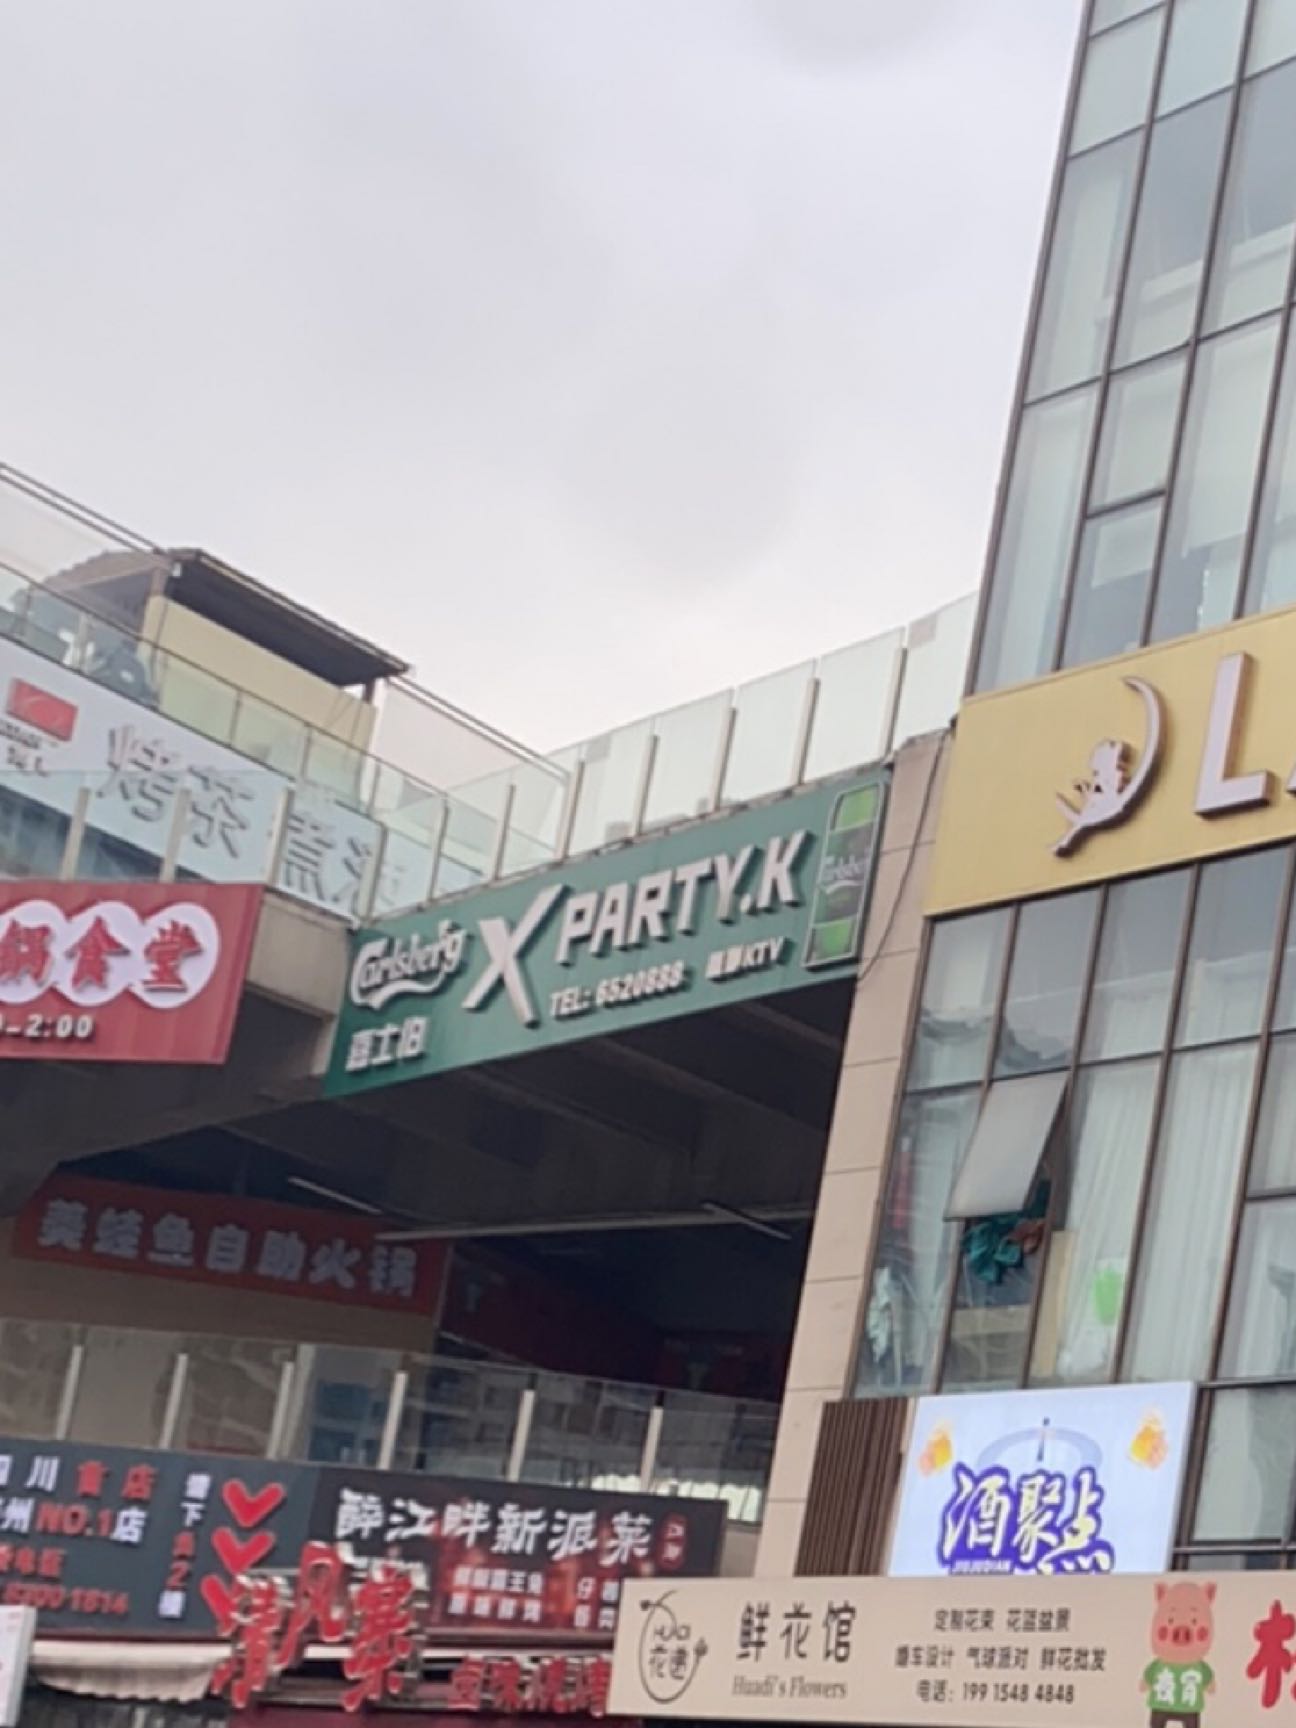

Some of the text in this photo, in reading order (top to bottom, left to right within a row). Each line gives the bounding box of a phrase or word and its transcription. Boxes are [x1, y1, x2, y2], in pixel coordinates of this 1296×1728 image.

[556, 830, 812, 964] PARTY.K
[351, 921, 469, 1009] Carlsberg
[462, 885, 567, 1027] X
[0, 1014, 95, 1038] -2:00
[737, 1601, 856, 1663] 鲜花馆
